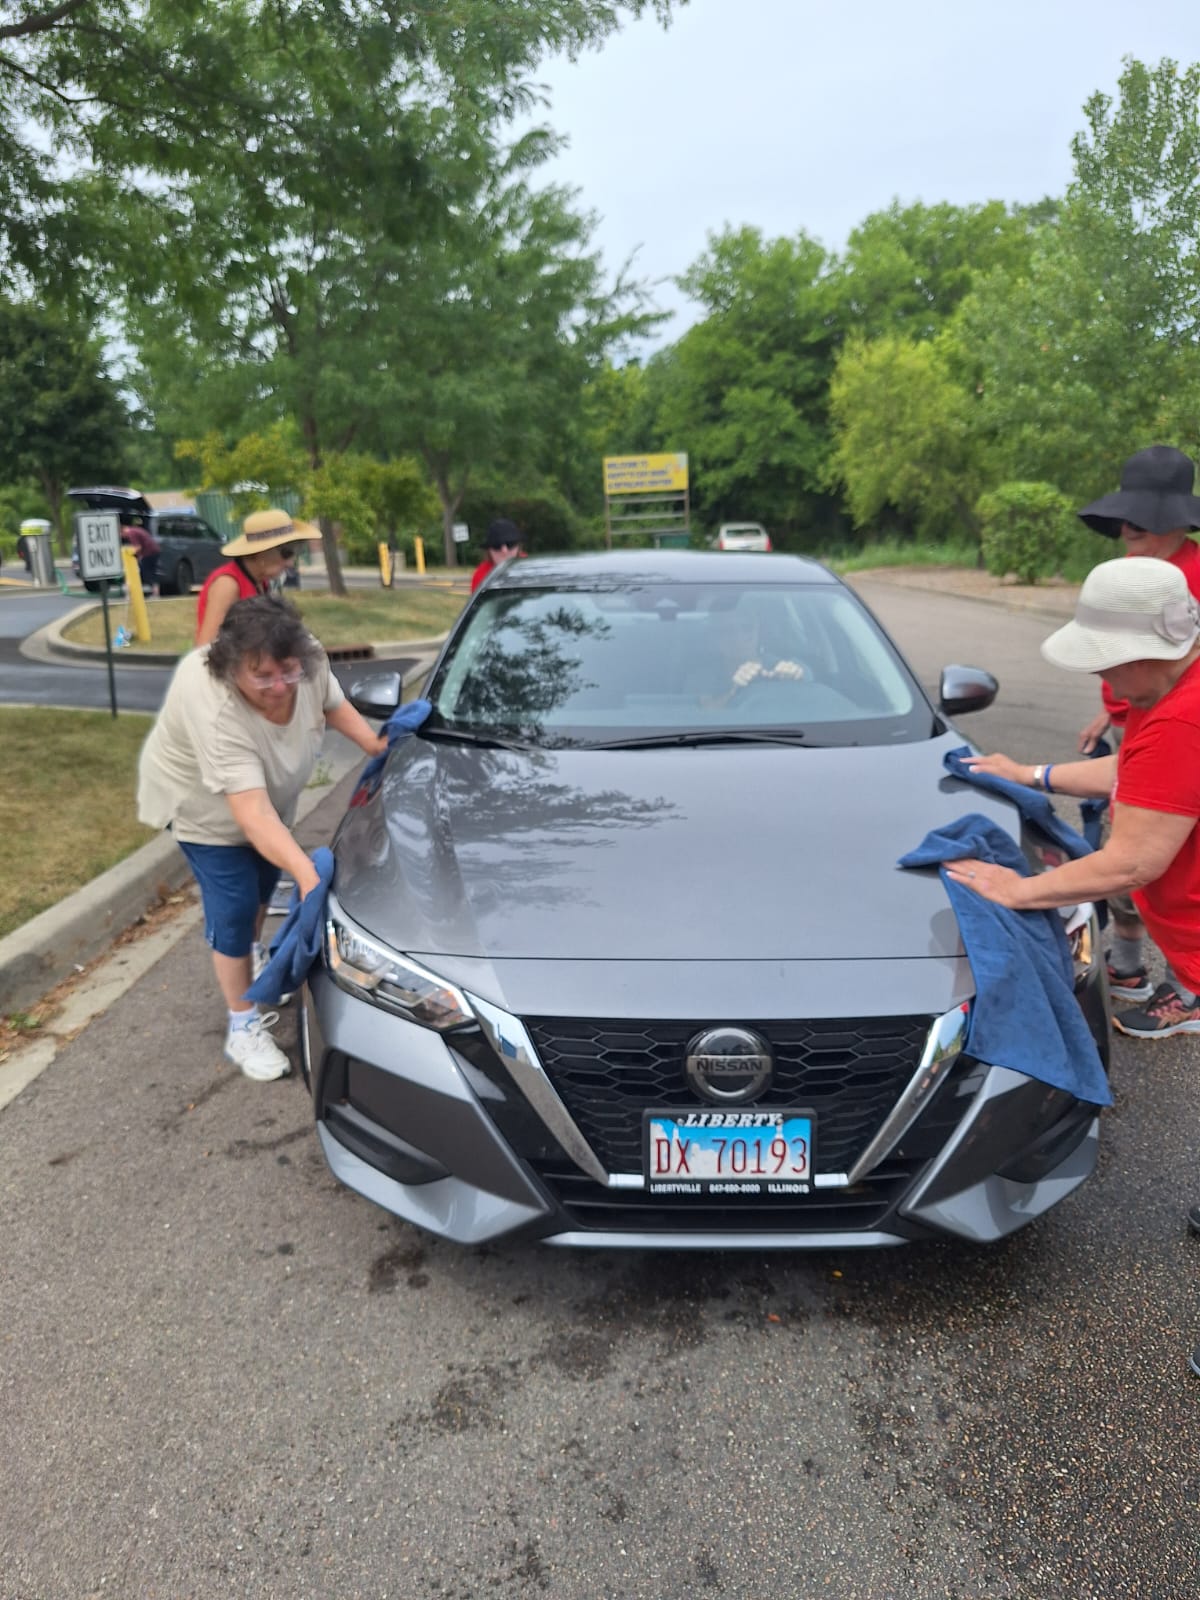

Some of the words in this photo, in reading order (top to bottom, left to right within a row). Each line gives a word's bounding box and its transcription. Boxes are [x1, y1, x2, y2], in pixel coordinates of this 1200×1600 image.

[88, 523, 110, 544] EXIT
[89, 547, 115, 569] ONLY
[696, 1061, 763, 1072] NISSAN
[685, 1113, 783, 1128] LIBERTY
[655, 1138, 691, 1174] DX
[711, 1138, 807, 1174] 70193
[650, 1184, 701, 1194] LIBERTYVILLE
[768, 1184, 810, 1194] ILLINOIS
